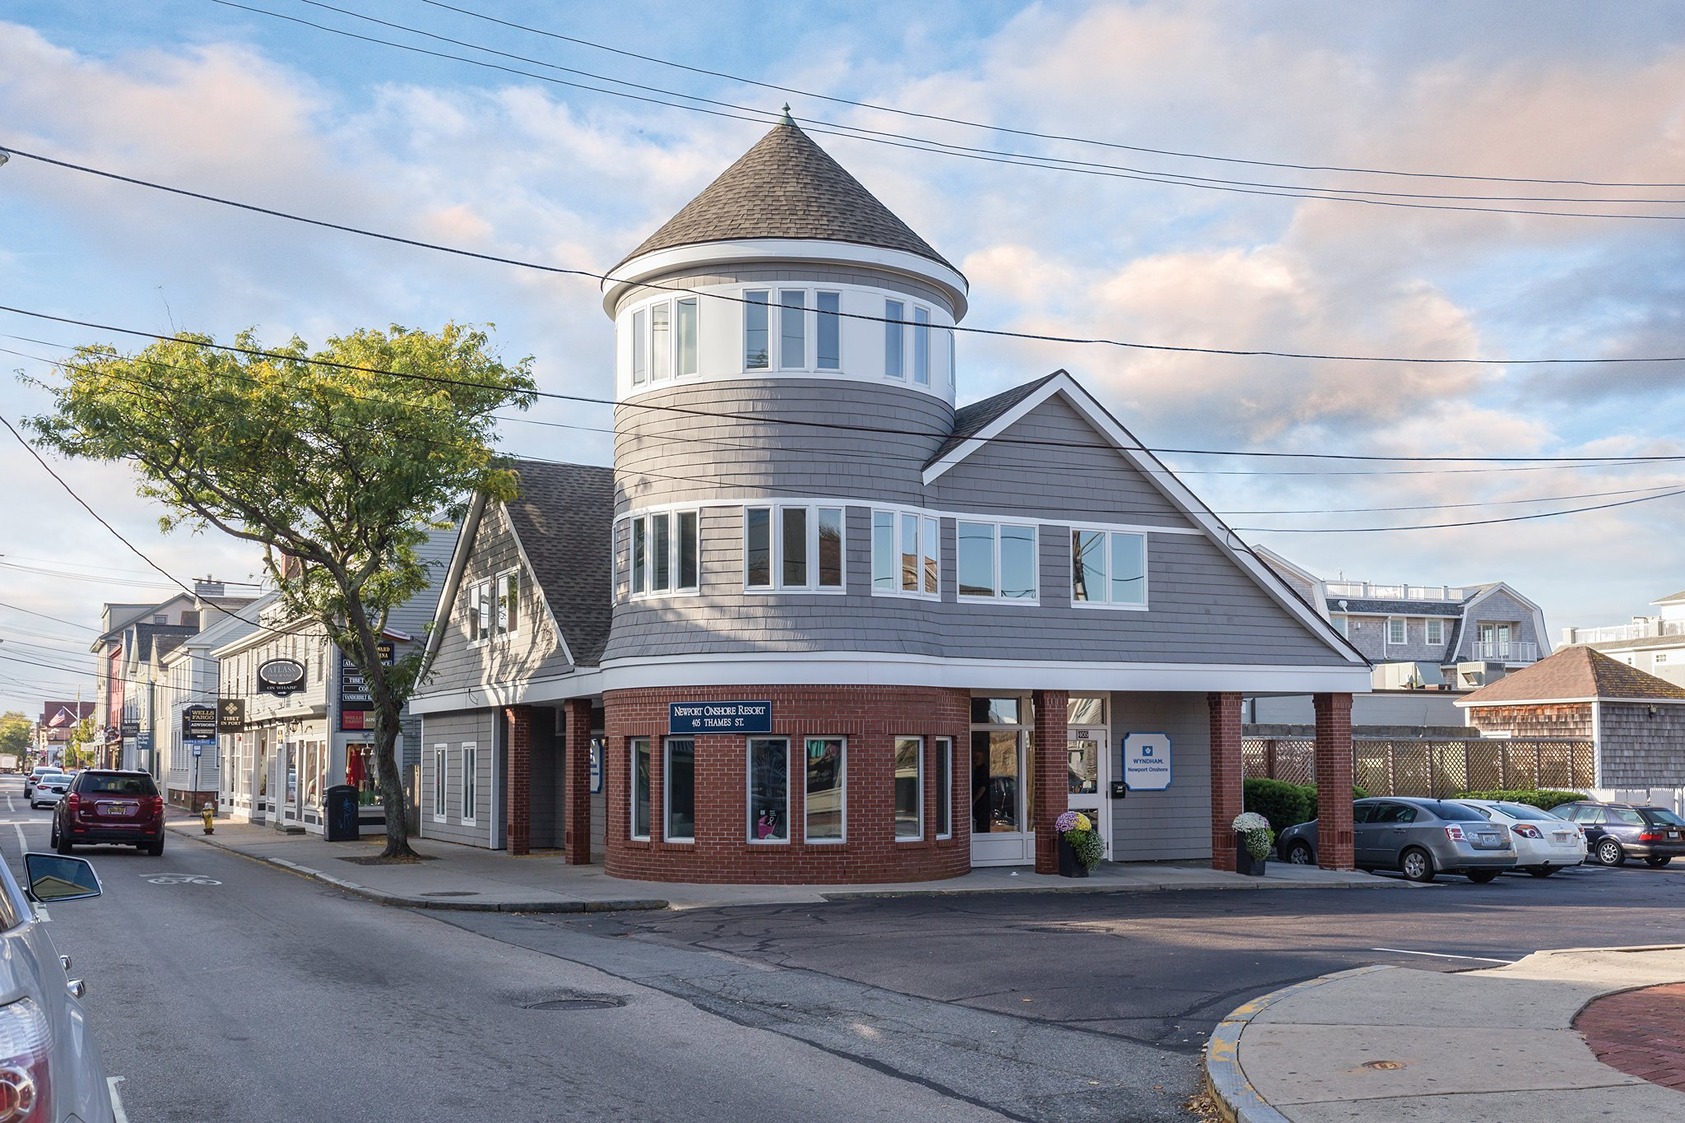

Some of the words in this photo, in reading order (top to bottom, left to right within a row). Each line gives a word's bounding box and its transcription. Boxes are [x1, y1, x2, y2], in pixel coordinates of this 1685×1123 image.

[691, 718, 701, 727] 405
[703, 718, 732, 727] THAMES
[734, 718, 744, 727] ST.
